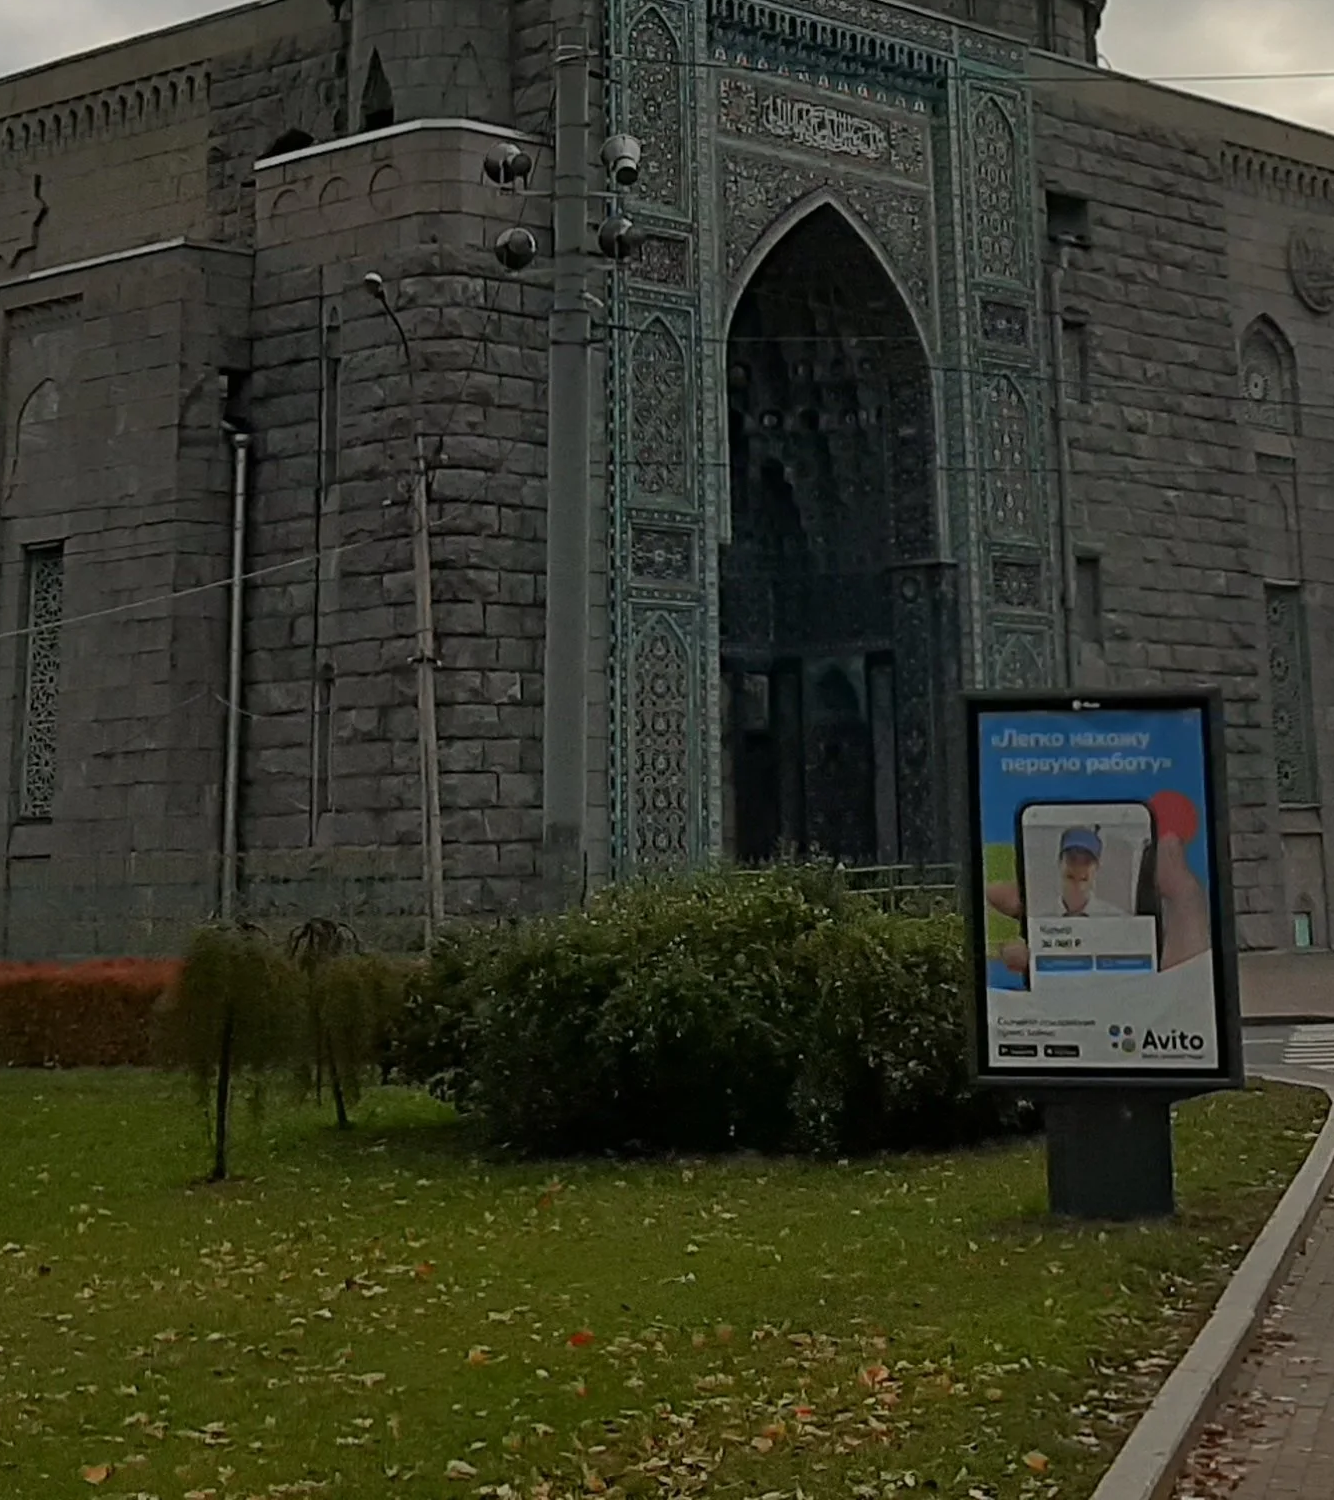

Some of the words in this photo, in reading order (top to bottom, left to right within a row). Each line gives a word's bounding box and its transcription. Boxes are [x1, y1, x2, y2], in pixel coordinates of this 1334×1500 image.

[990, 728, 1064, 749] «Легко
[1070, 731, 1150, 750] нахожу
[1001, 755, 1081, 775] первую
[1085, 752, 1172, 776] работу»
[1142, 1028, 1204, 1051] Avito
